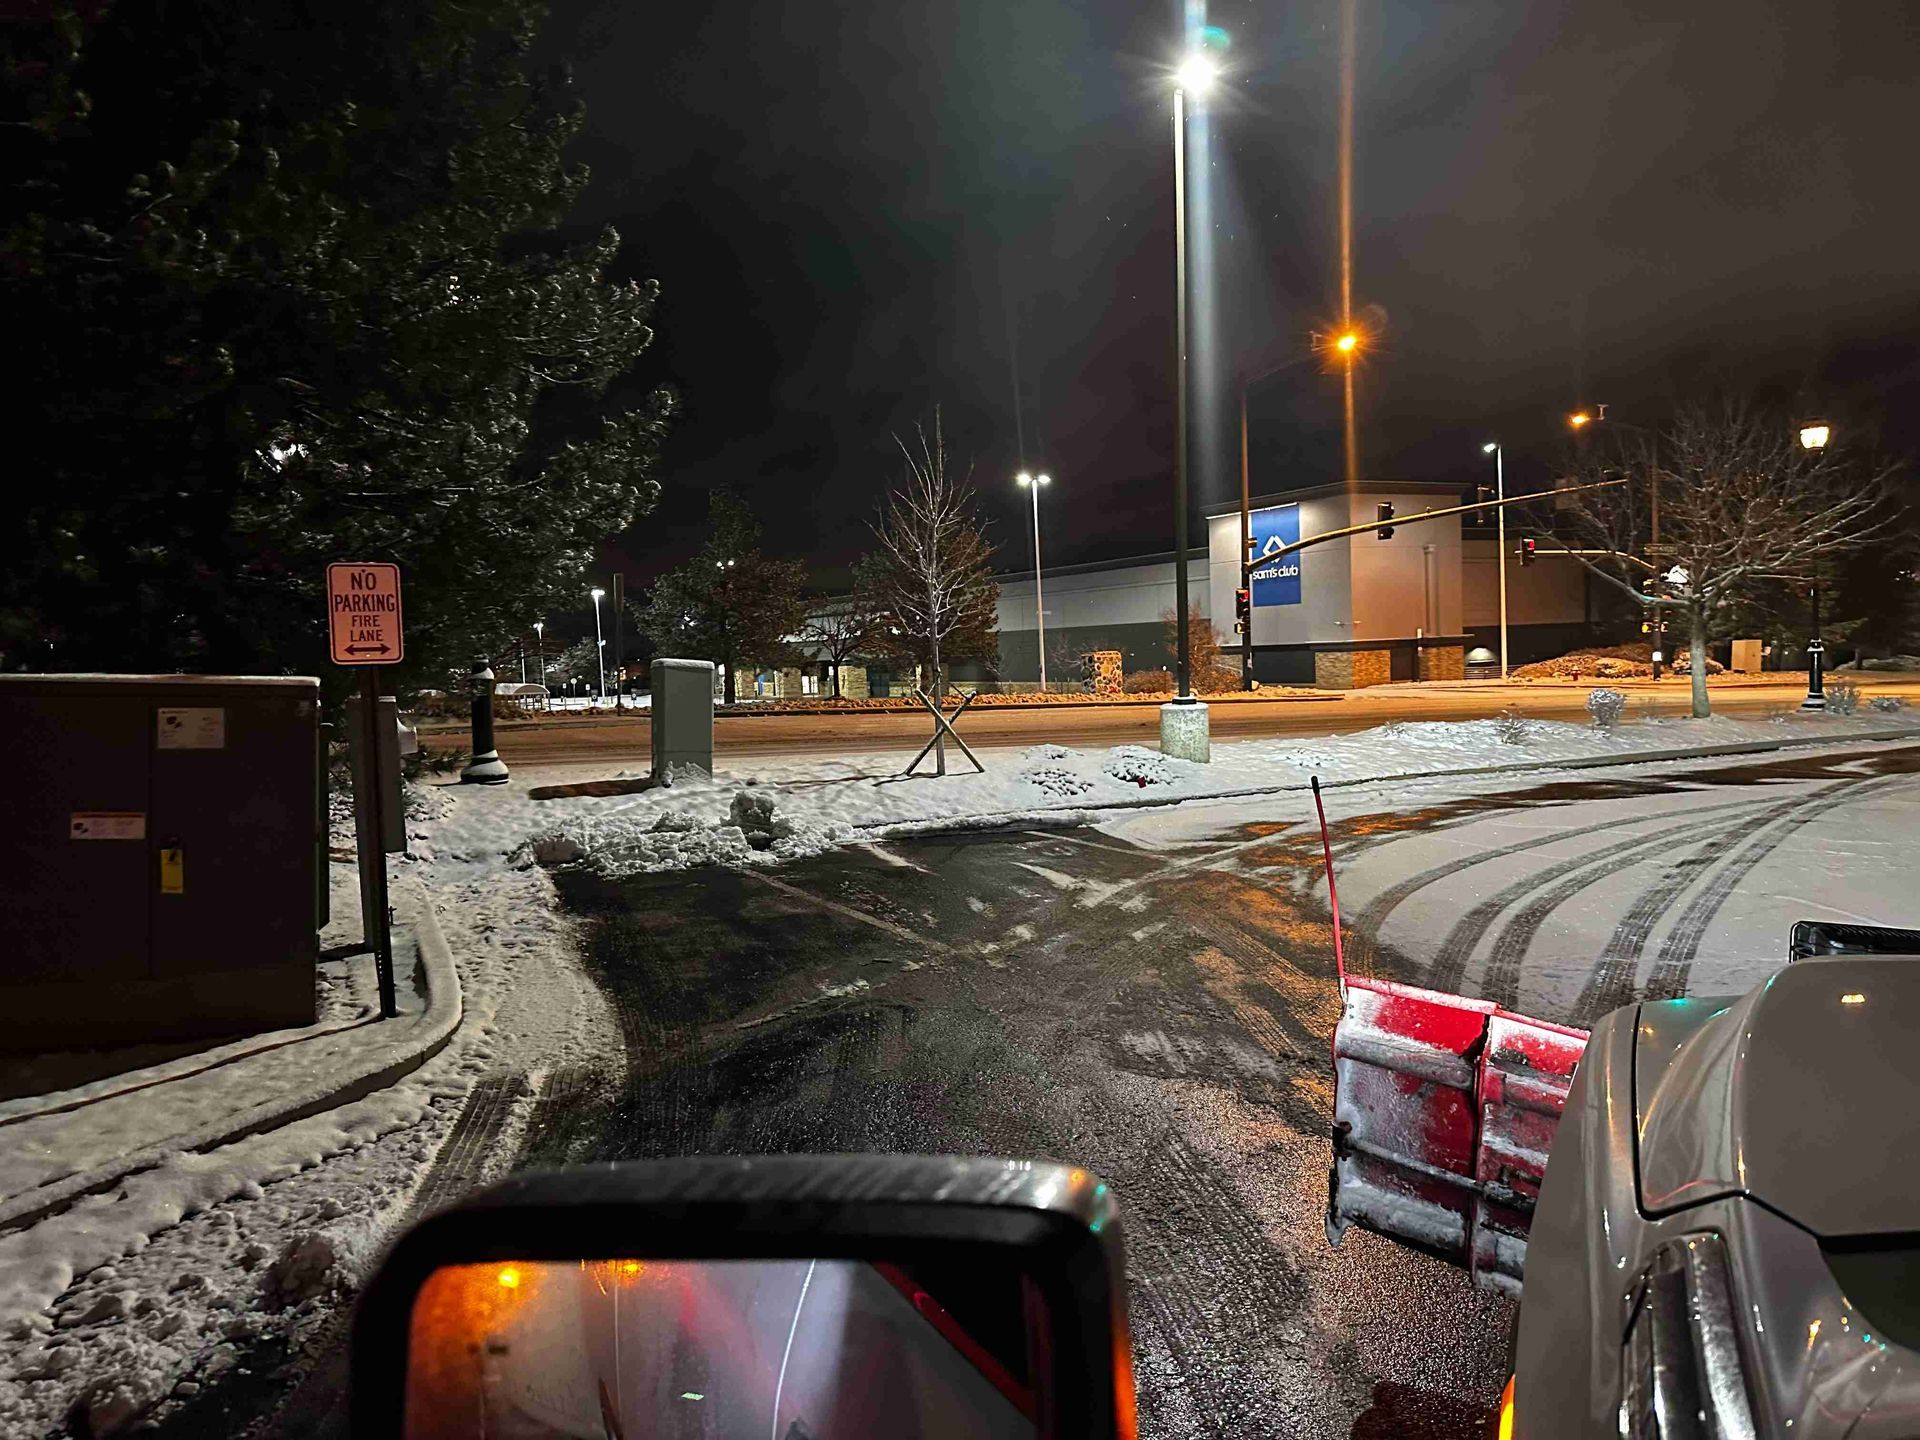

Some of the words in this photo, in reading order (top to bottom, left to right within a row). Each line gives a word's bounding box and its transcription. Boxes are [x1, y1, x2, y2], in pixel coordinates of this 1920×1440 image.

[1252, 567, 1277, 580] sam's
[1278, 565, 1298, 578] club
[351, 572, 377, 591] NO
[334, 594, 396, 612] PARKING
[352, 615, 380, 628] FIRE
[350, 629, 384, 642] LANE
